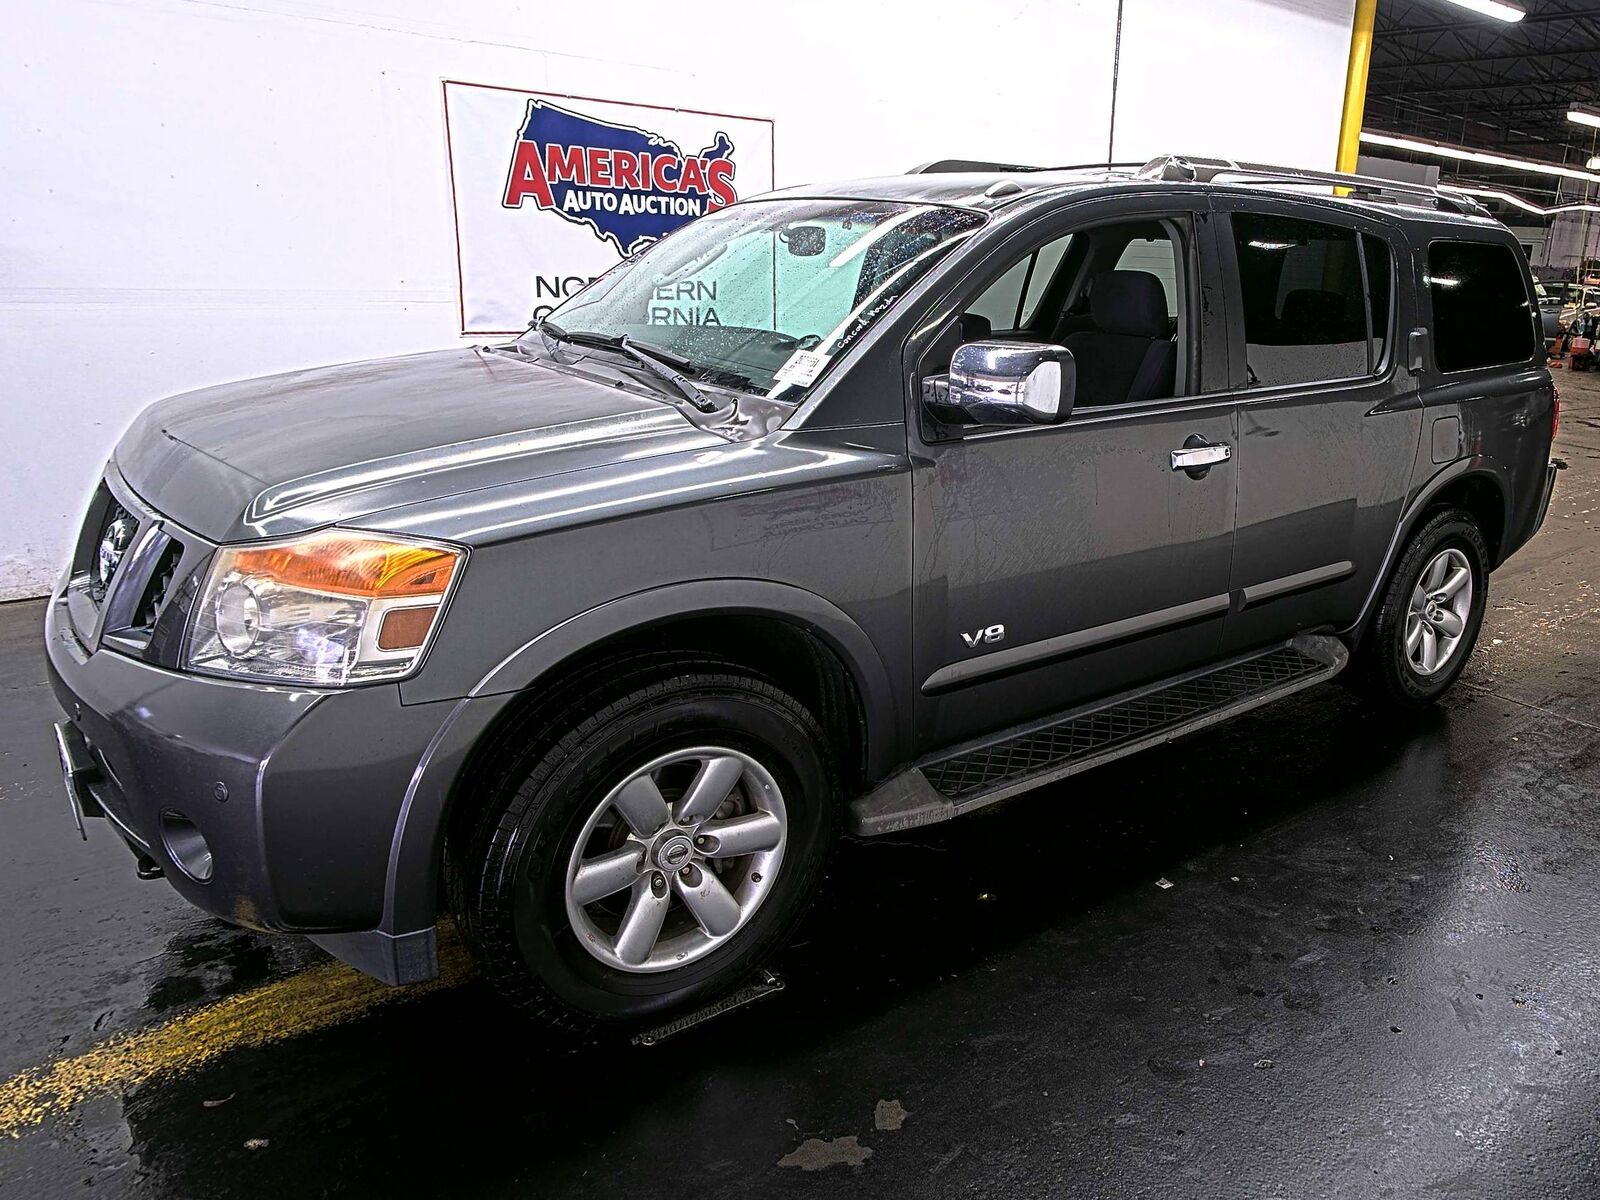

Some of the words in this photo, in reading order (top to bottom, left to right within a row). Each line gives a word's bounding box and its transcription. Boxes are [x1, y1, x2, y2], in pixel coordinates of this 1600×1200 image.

[504, 139, 737, 213] AMERICA'S
[562, 189, 615, 213] AUTO
[618, 191, 701, 217] AUCTION
[960, 624, 1005, 648] V8
